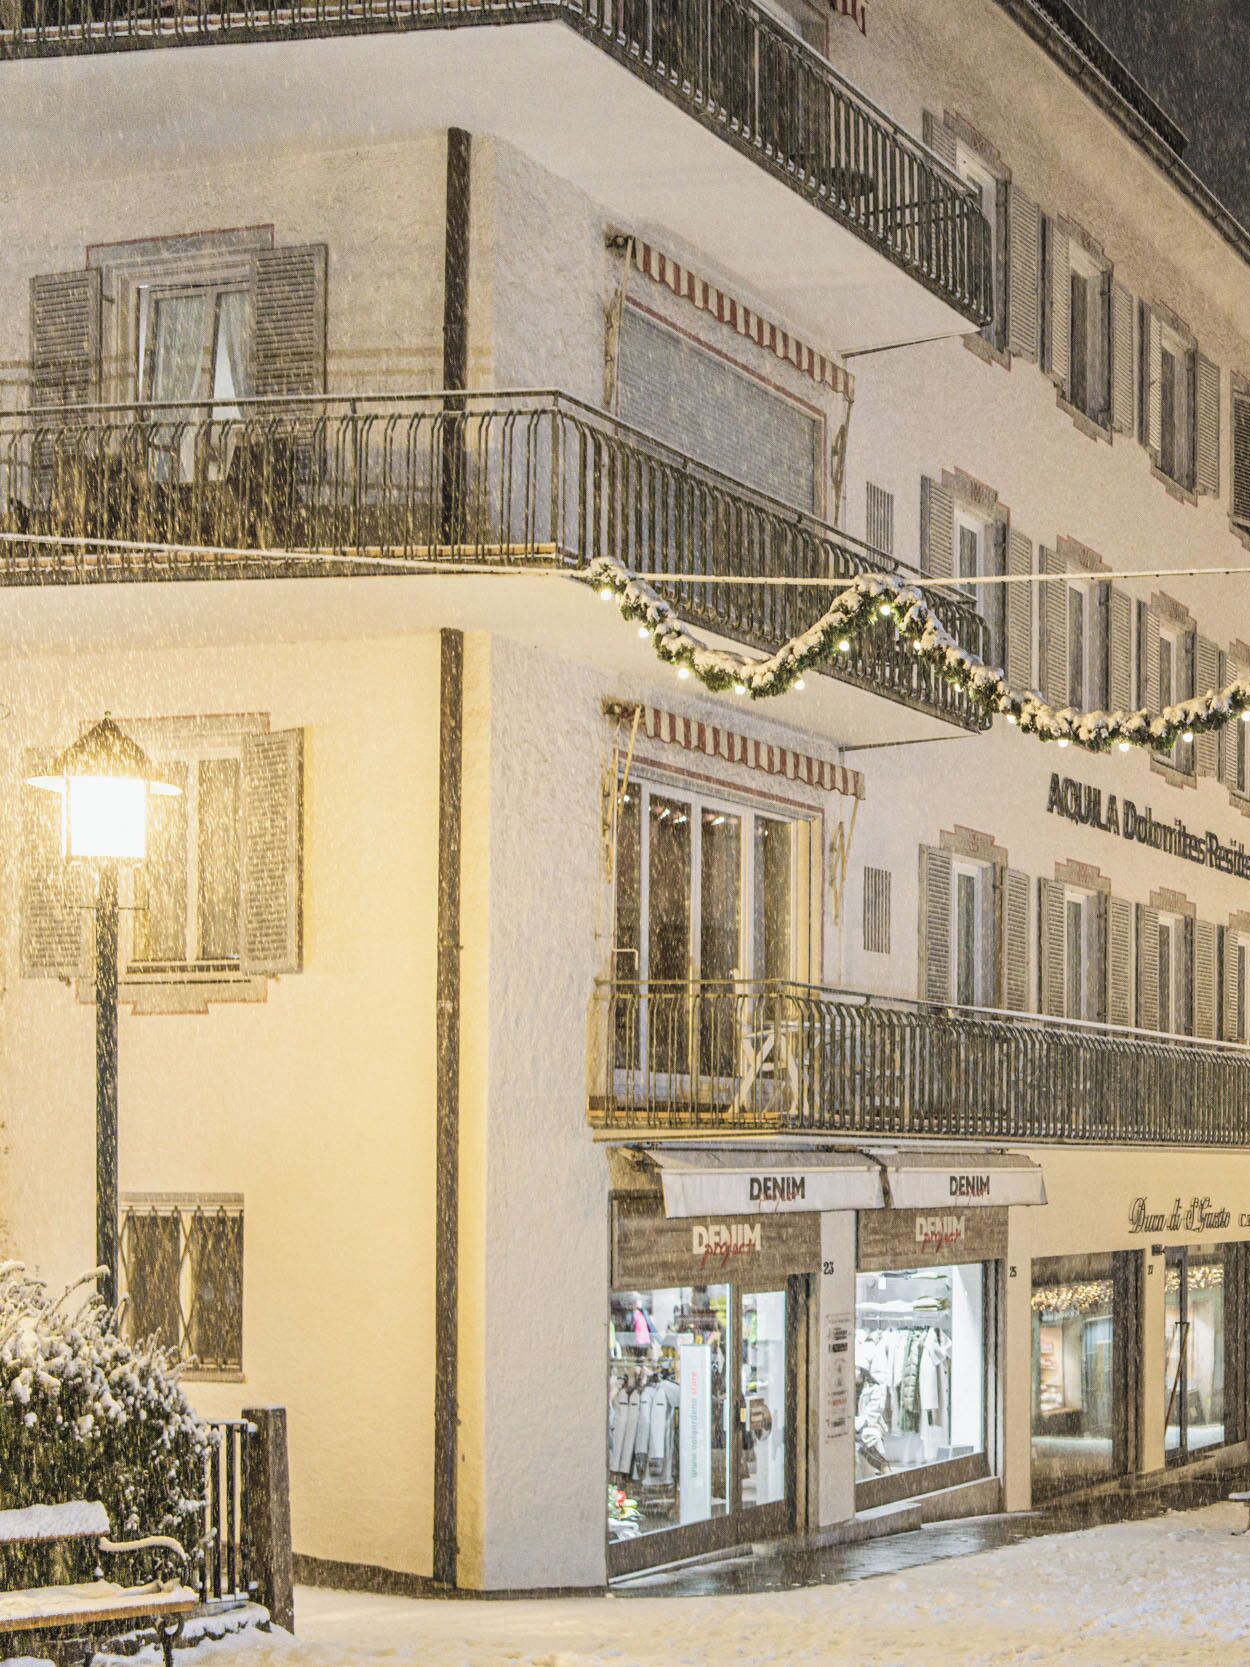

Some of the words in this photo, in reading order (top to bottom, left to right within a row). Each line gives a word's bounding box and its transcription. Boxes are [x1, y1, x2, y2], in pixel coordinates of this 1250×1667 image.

[1047, 772, 1120, 836] AQUILA
[750, 1176, 805, 1201] DENIM
[949, 1175, 990, 1197] DENIM
[693, 1223, 761, 1254] DENIM
[915, 1215, 966, 1242] DENIM
[823, 1261, 834, 1275] 23
[1009, 1265, 1017, 1278] 25
